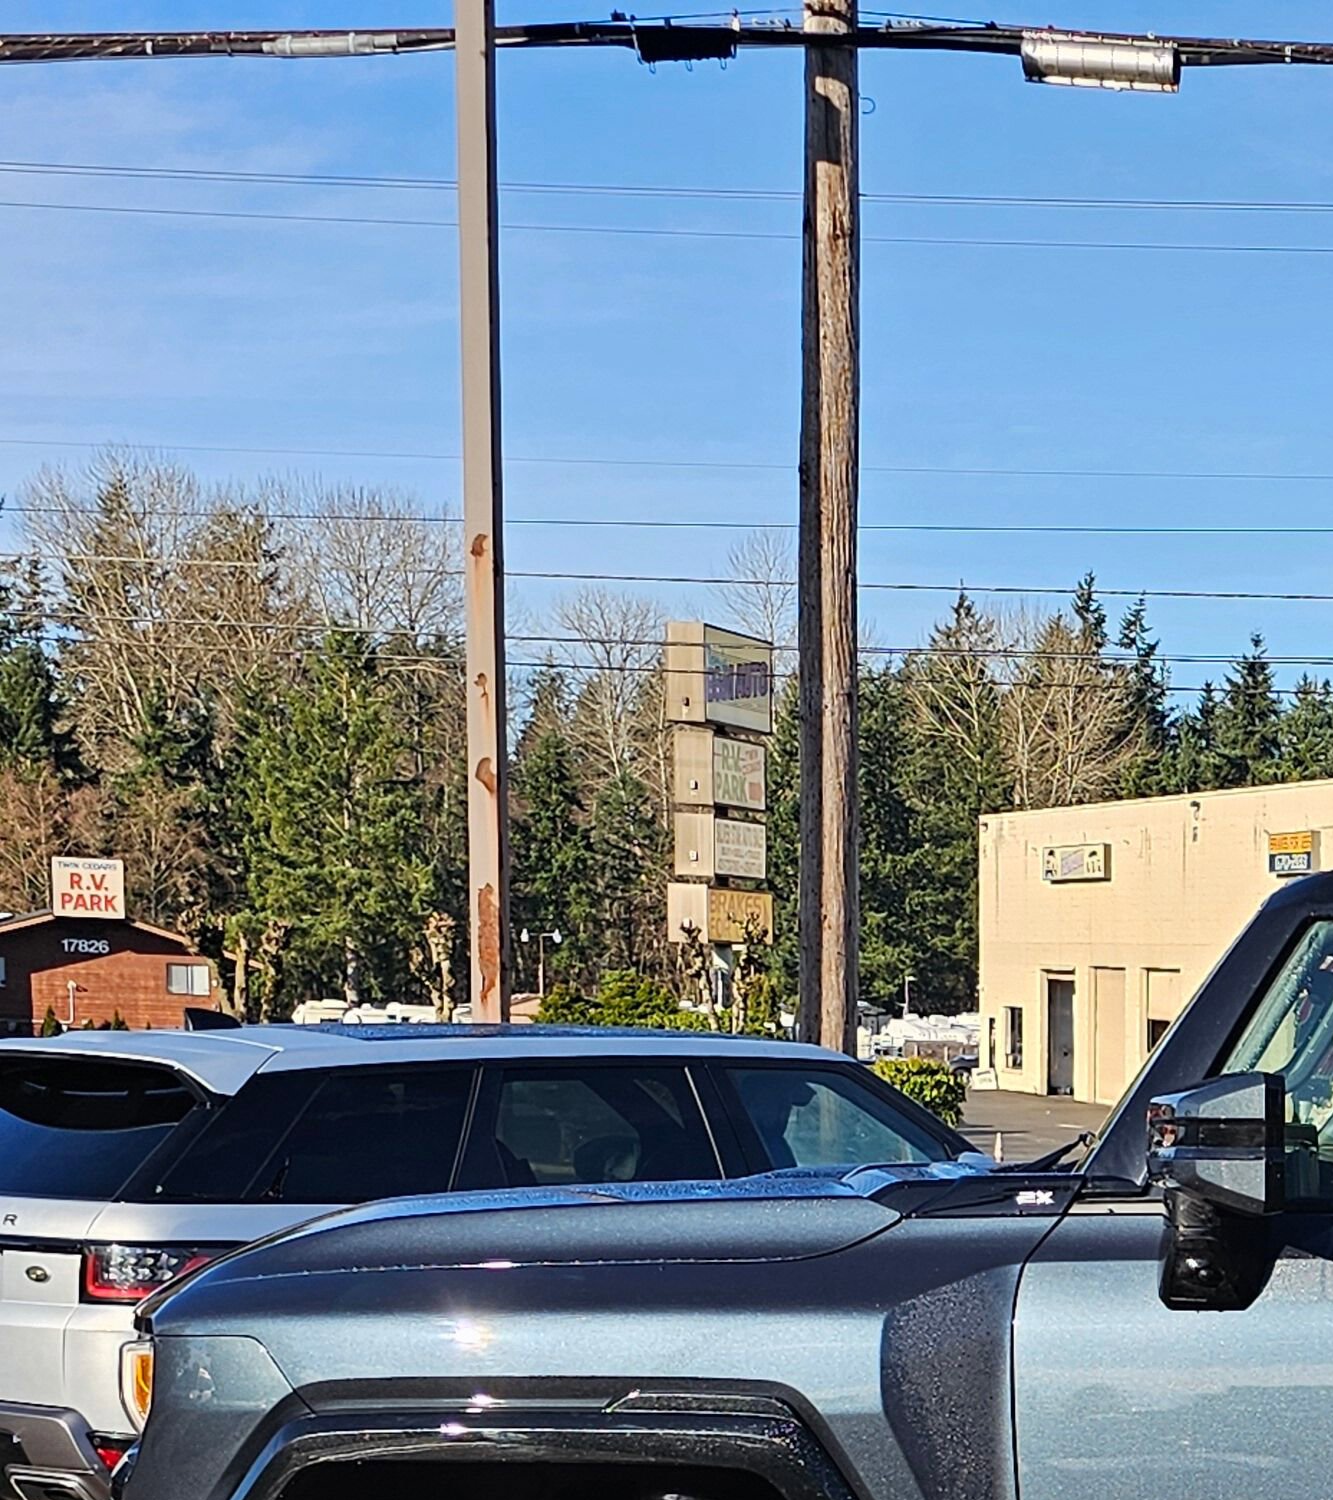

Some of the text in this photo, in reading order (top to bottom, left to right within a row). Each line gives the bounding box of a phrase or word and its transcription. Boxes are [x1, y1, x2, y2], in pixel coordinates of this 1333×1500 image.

[69, 872, 109, 891] R.V.
[60, 892, 118, 912] PARK
[61, 938, 110, 954] 17826
[3, 1213, 18, 1226] R
